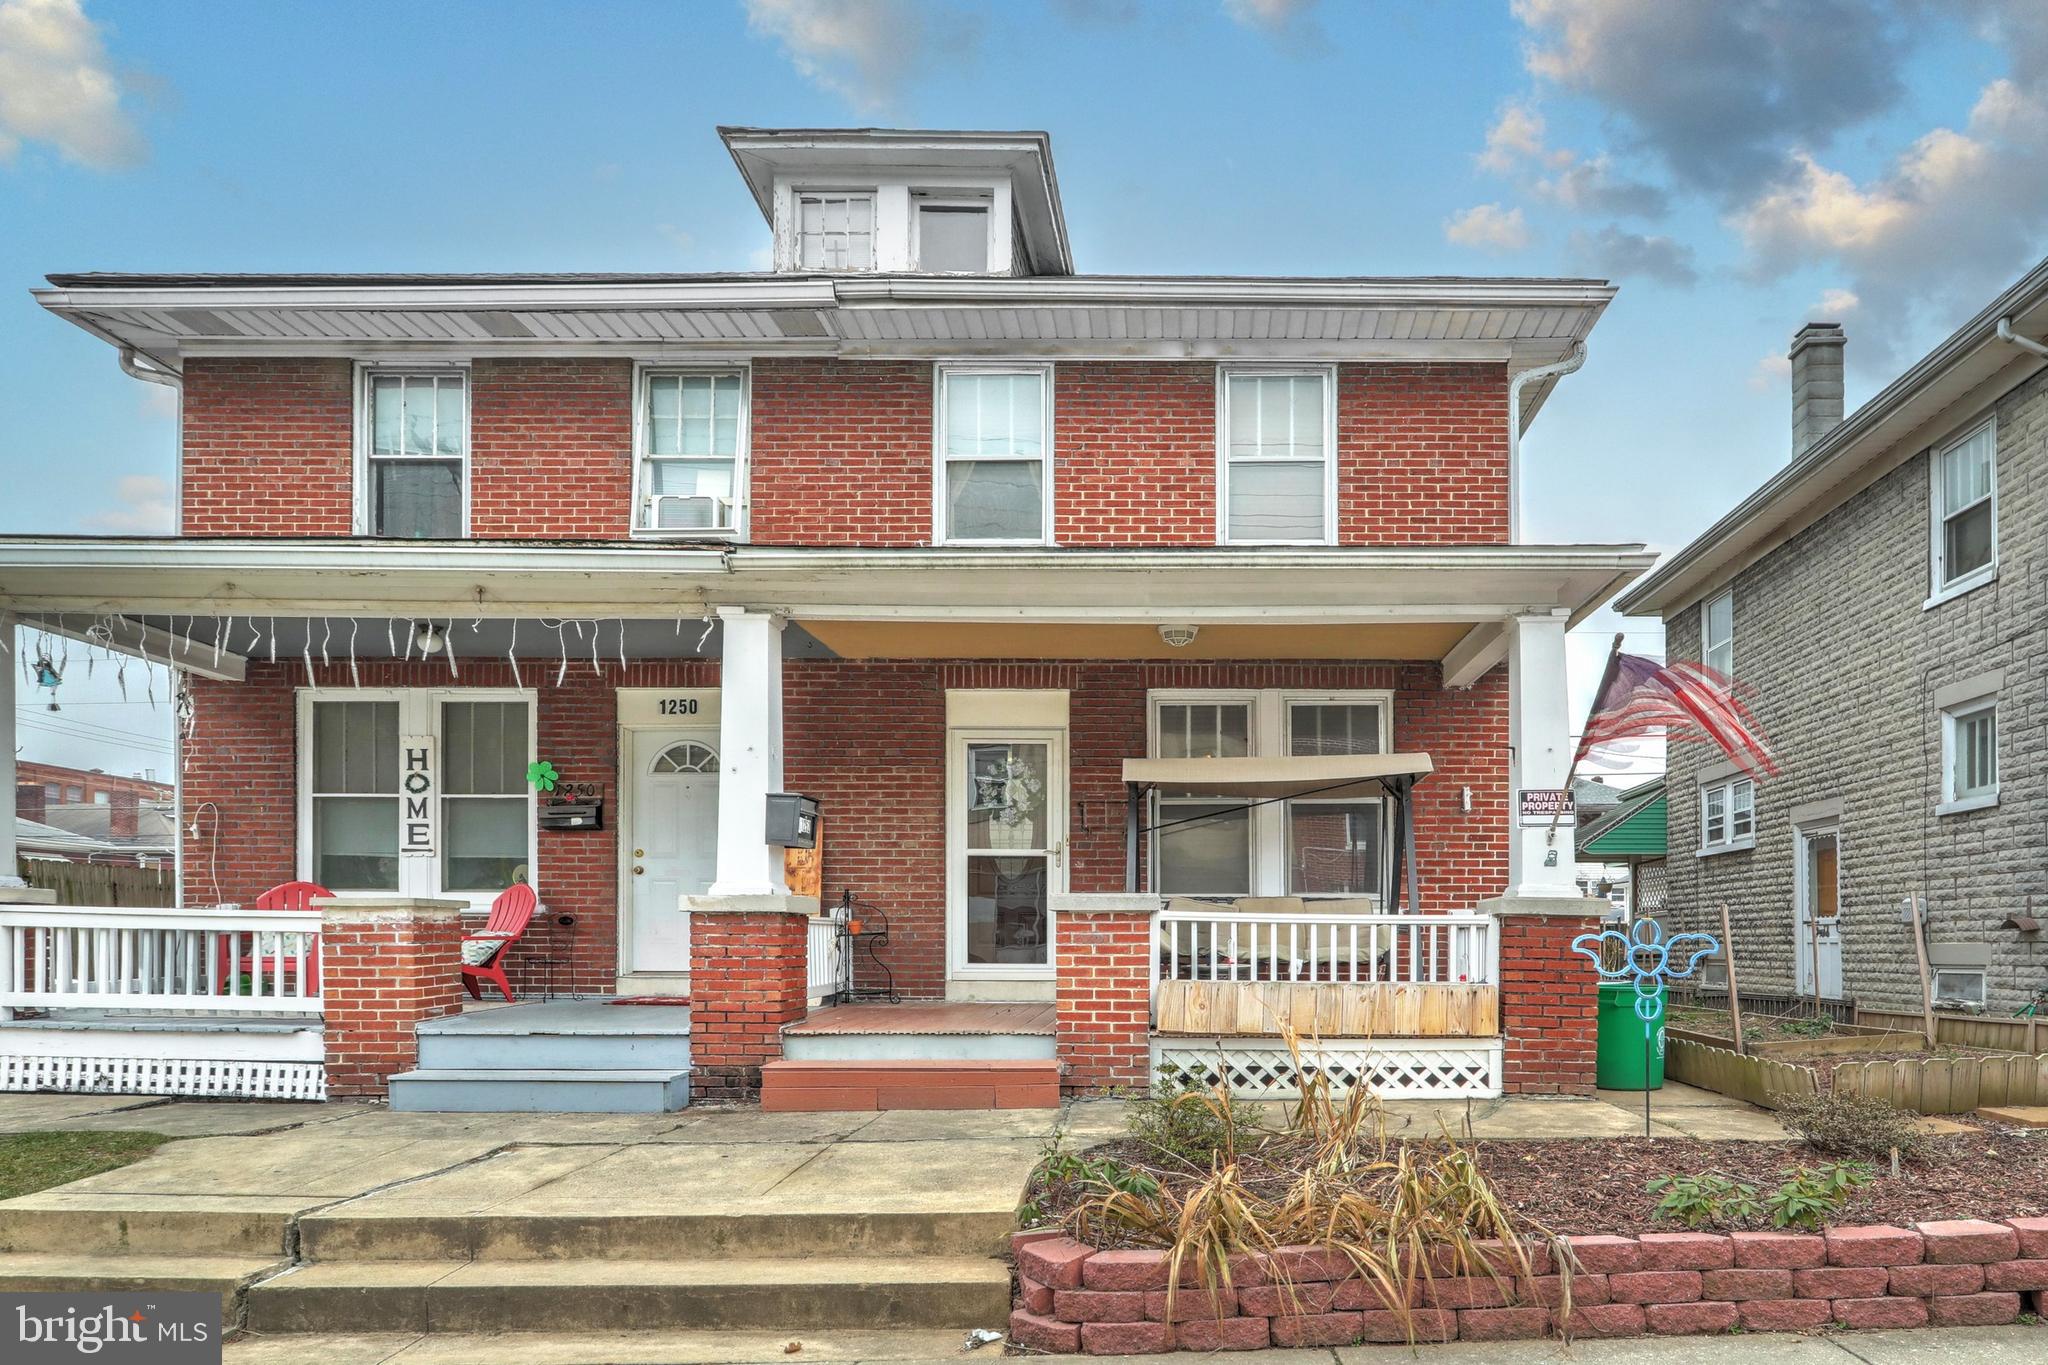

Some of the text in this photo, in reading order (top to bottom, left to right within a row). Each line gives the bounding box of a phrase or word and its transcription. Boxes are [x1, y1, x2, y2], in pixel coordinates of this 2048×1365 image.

[659, 699, 698, 715] 1250
[404, 748, 431, 846] HOME
[555, 783, 595, 797] 1250
